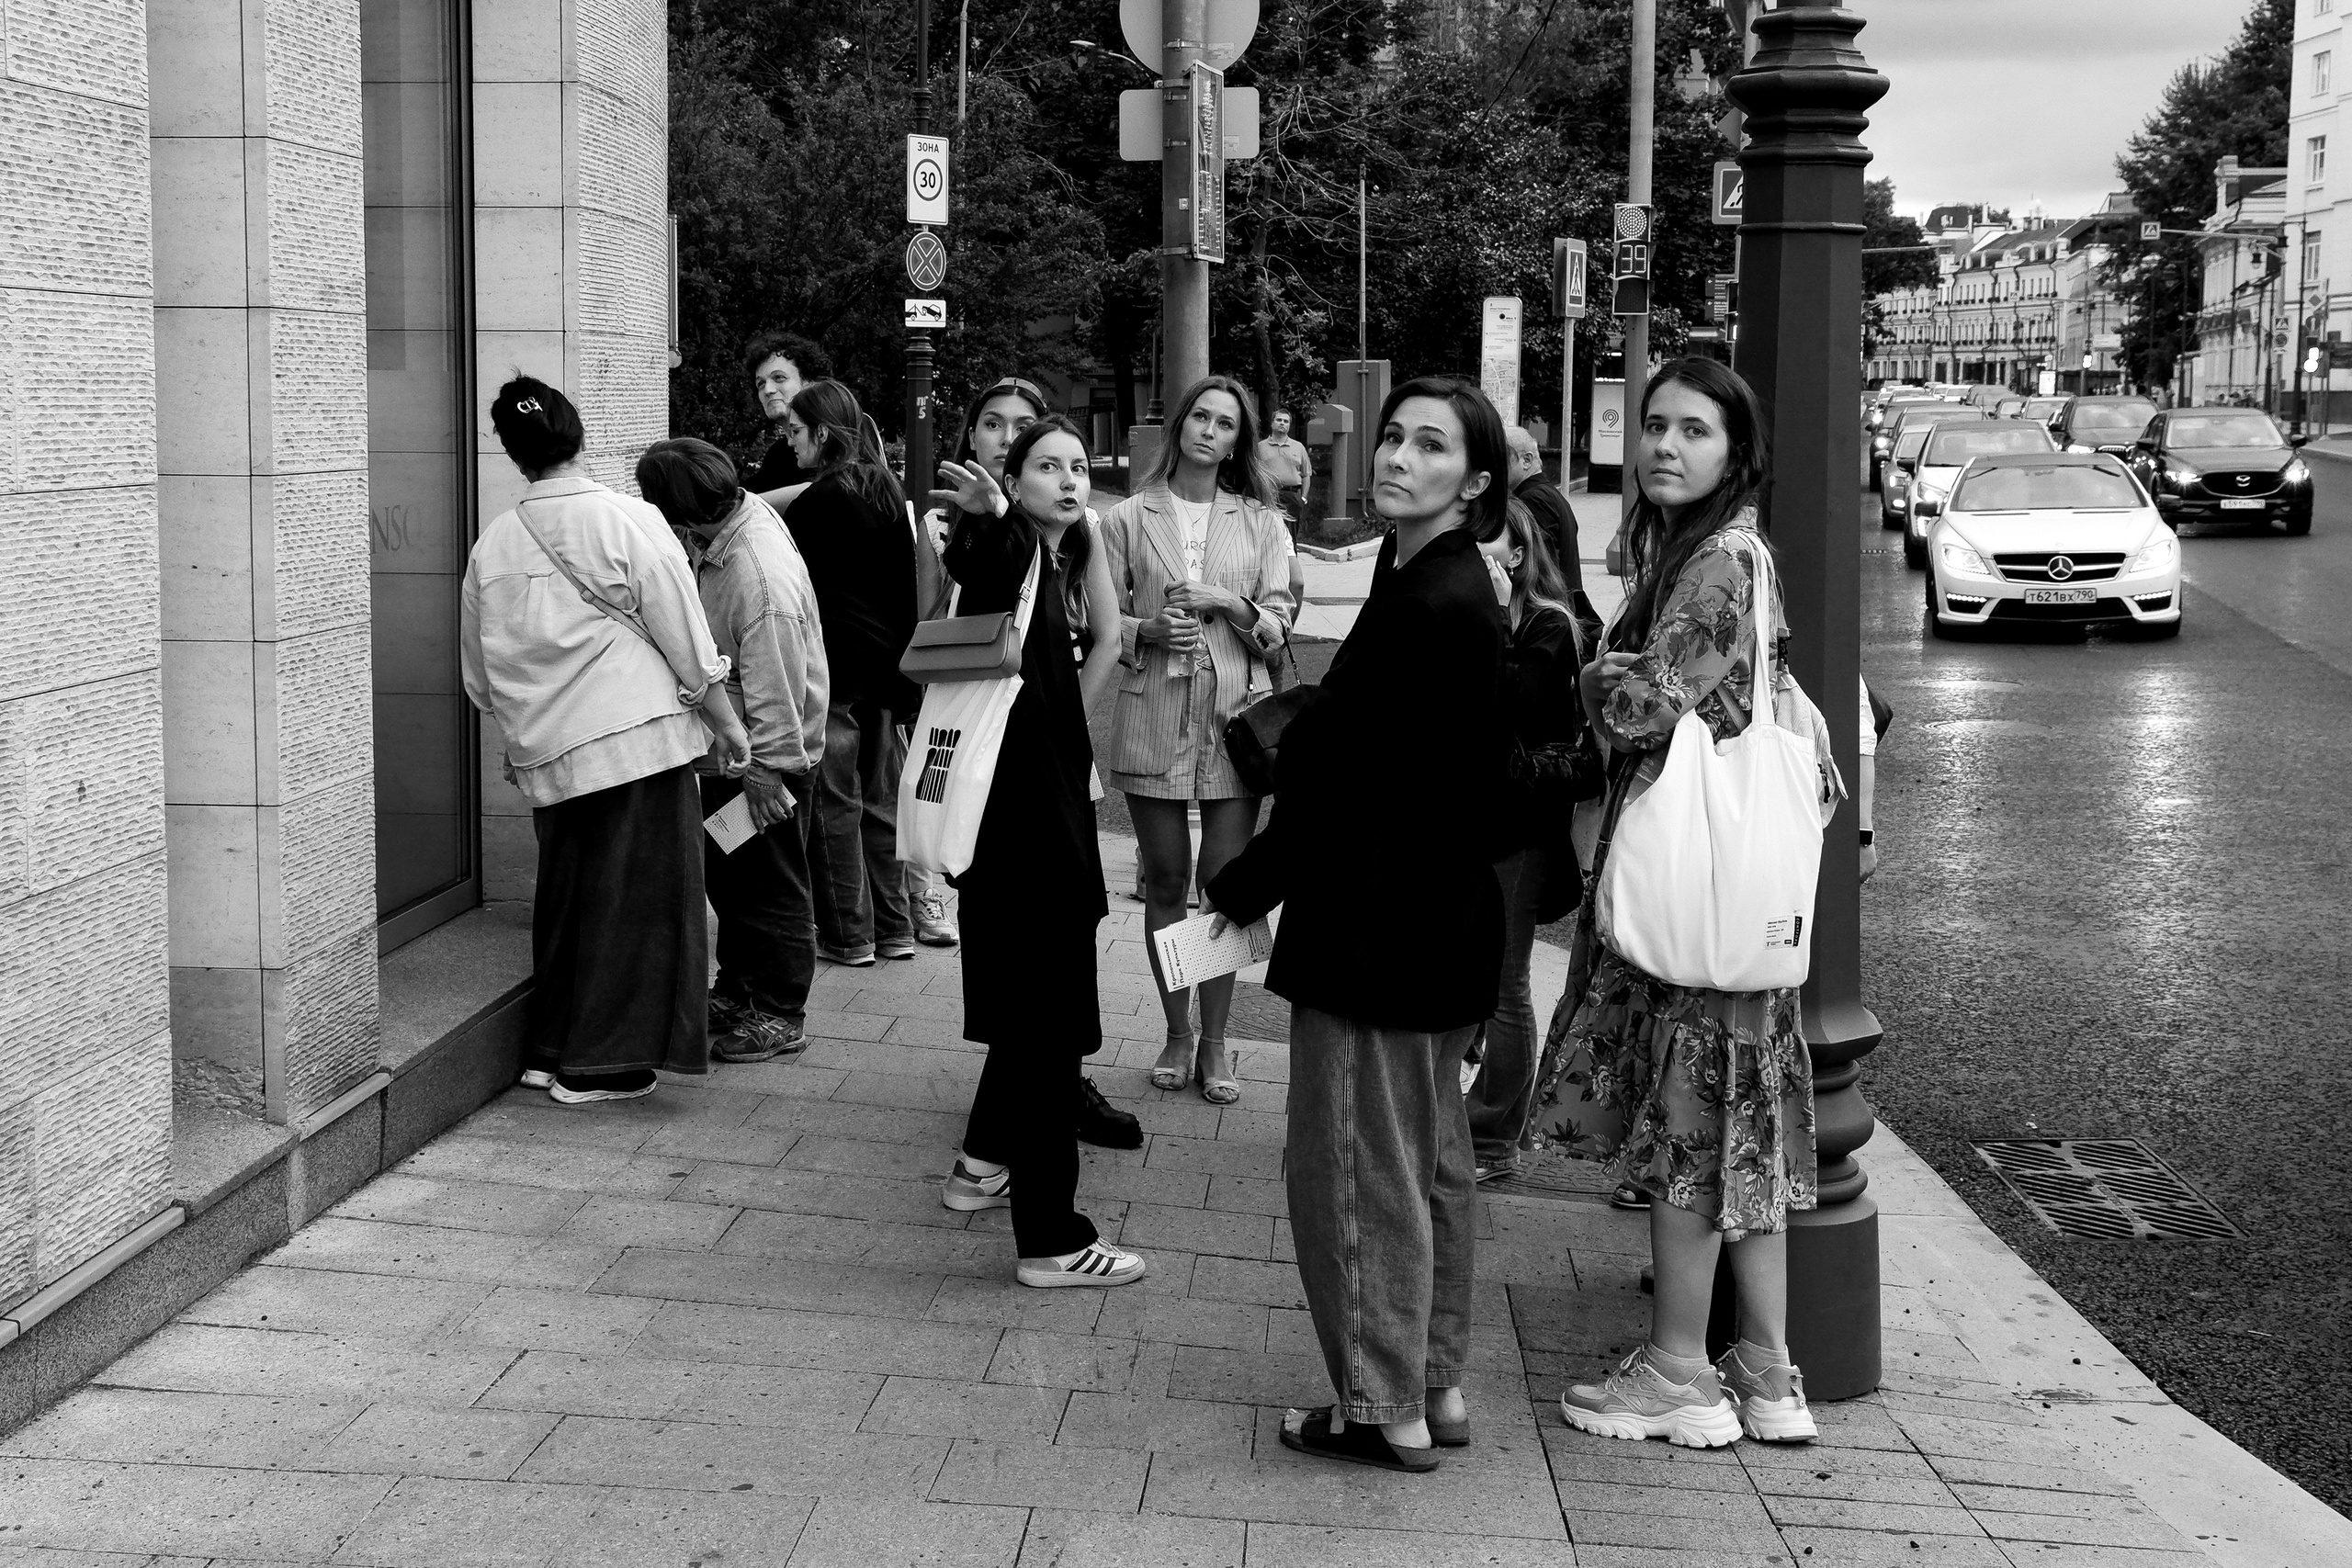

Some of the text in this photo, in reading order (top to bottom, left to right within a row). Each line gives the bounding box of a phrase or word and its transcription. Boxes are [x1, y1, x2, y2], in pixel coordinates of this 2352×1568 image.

[917, 141, 940, 153] ЗОНА
[920, 171, 936, 188] 30
[1622, 244, 1646, 273] 39
[918, 406, 926, 419] 5
[1176, 965, 1184, 984] Парк
